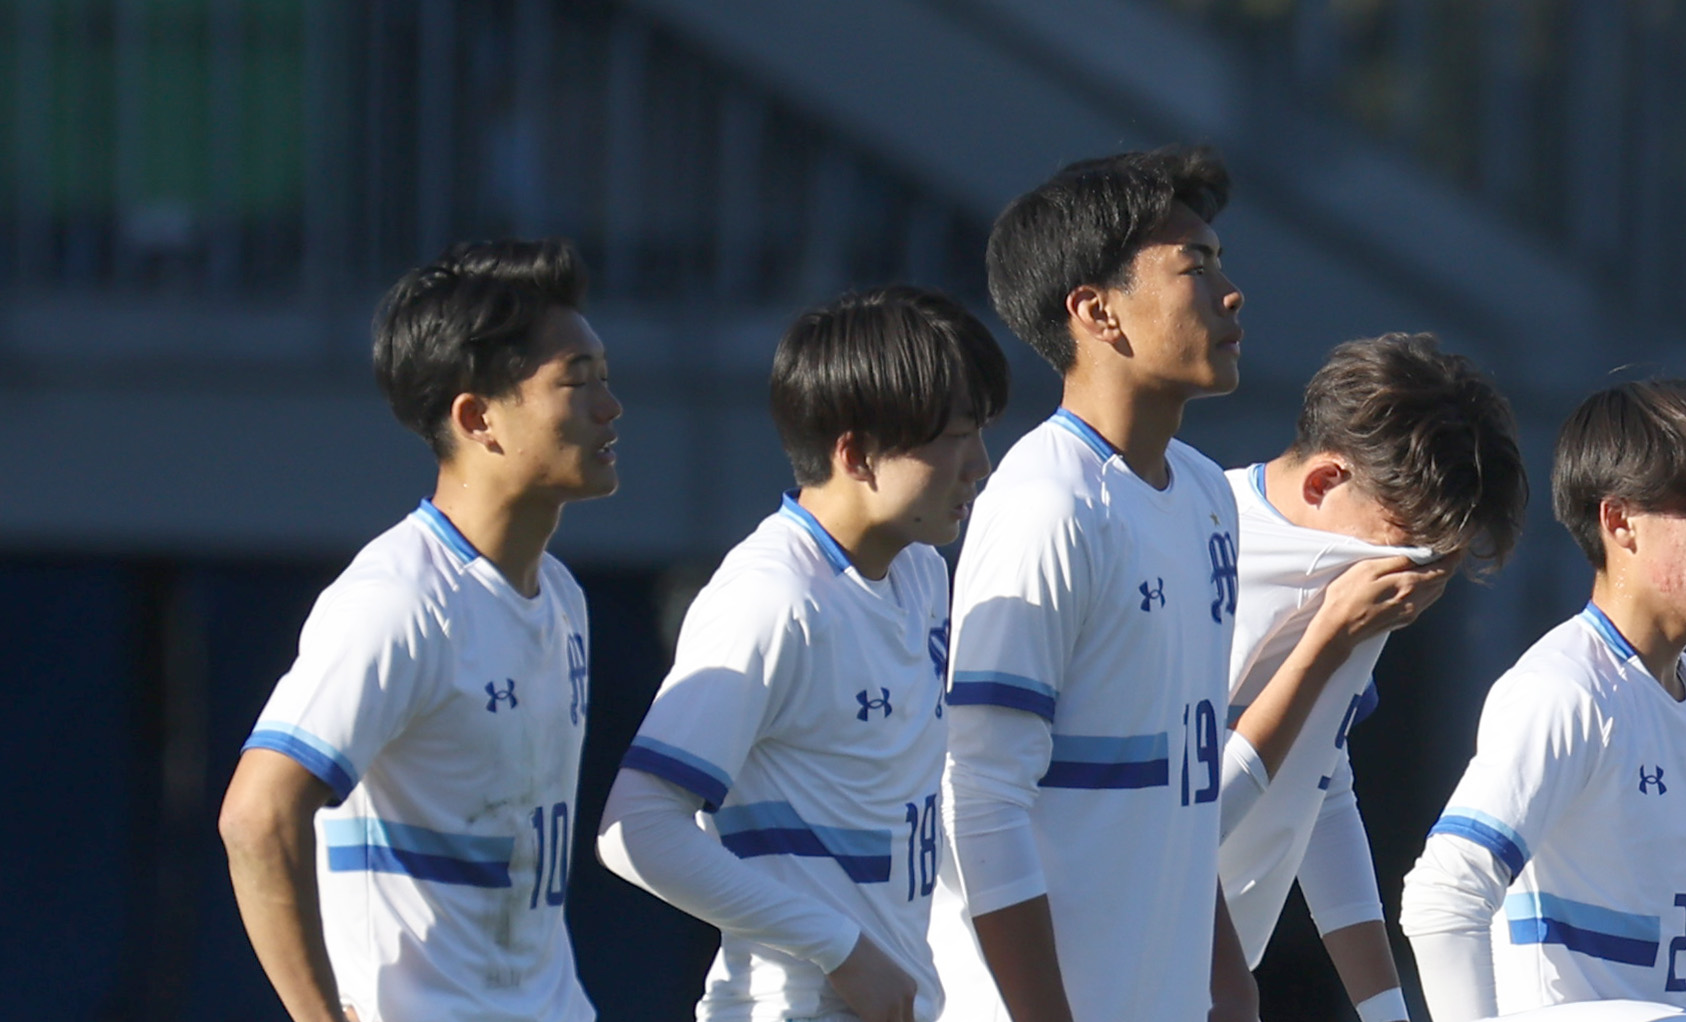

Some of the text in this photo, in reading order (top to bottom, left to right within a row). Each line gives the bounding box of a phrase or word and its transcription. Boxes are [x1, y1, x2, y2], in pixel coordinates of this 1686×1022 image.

[1181, 699, 1220, 806] 19
[530, 801, 568, 909] 10
[905, 793, 937, 901] 18
